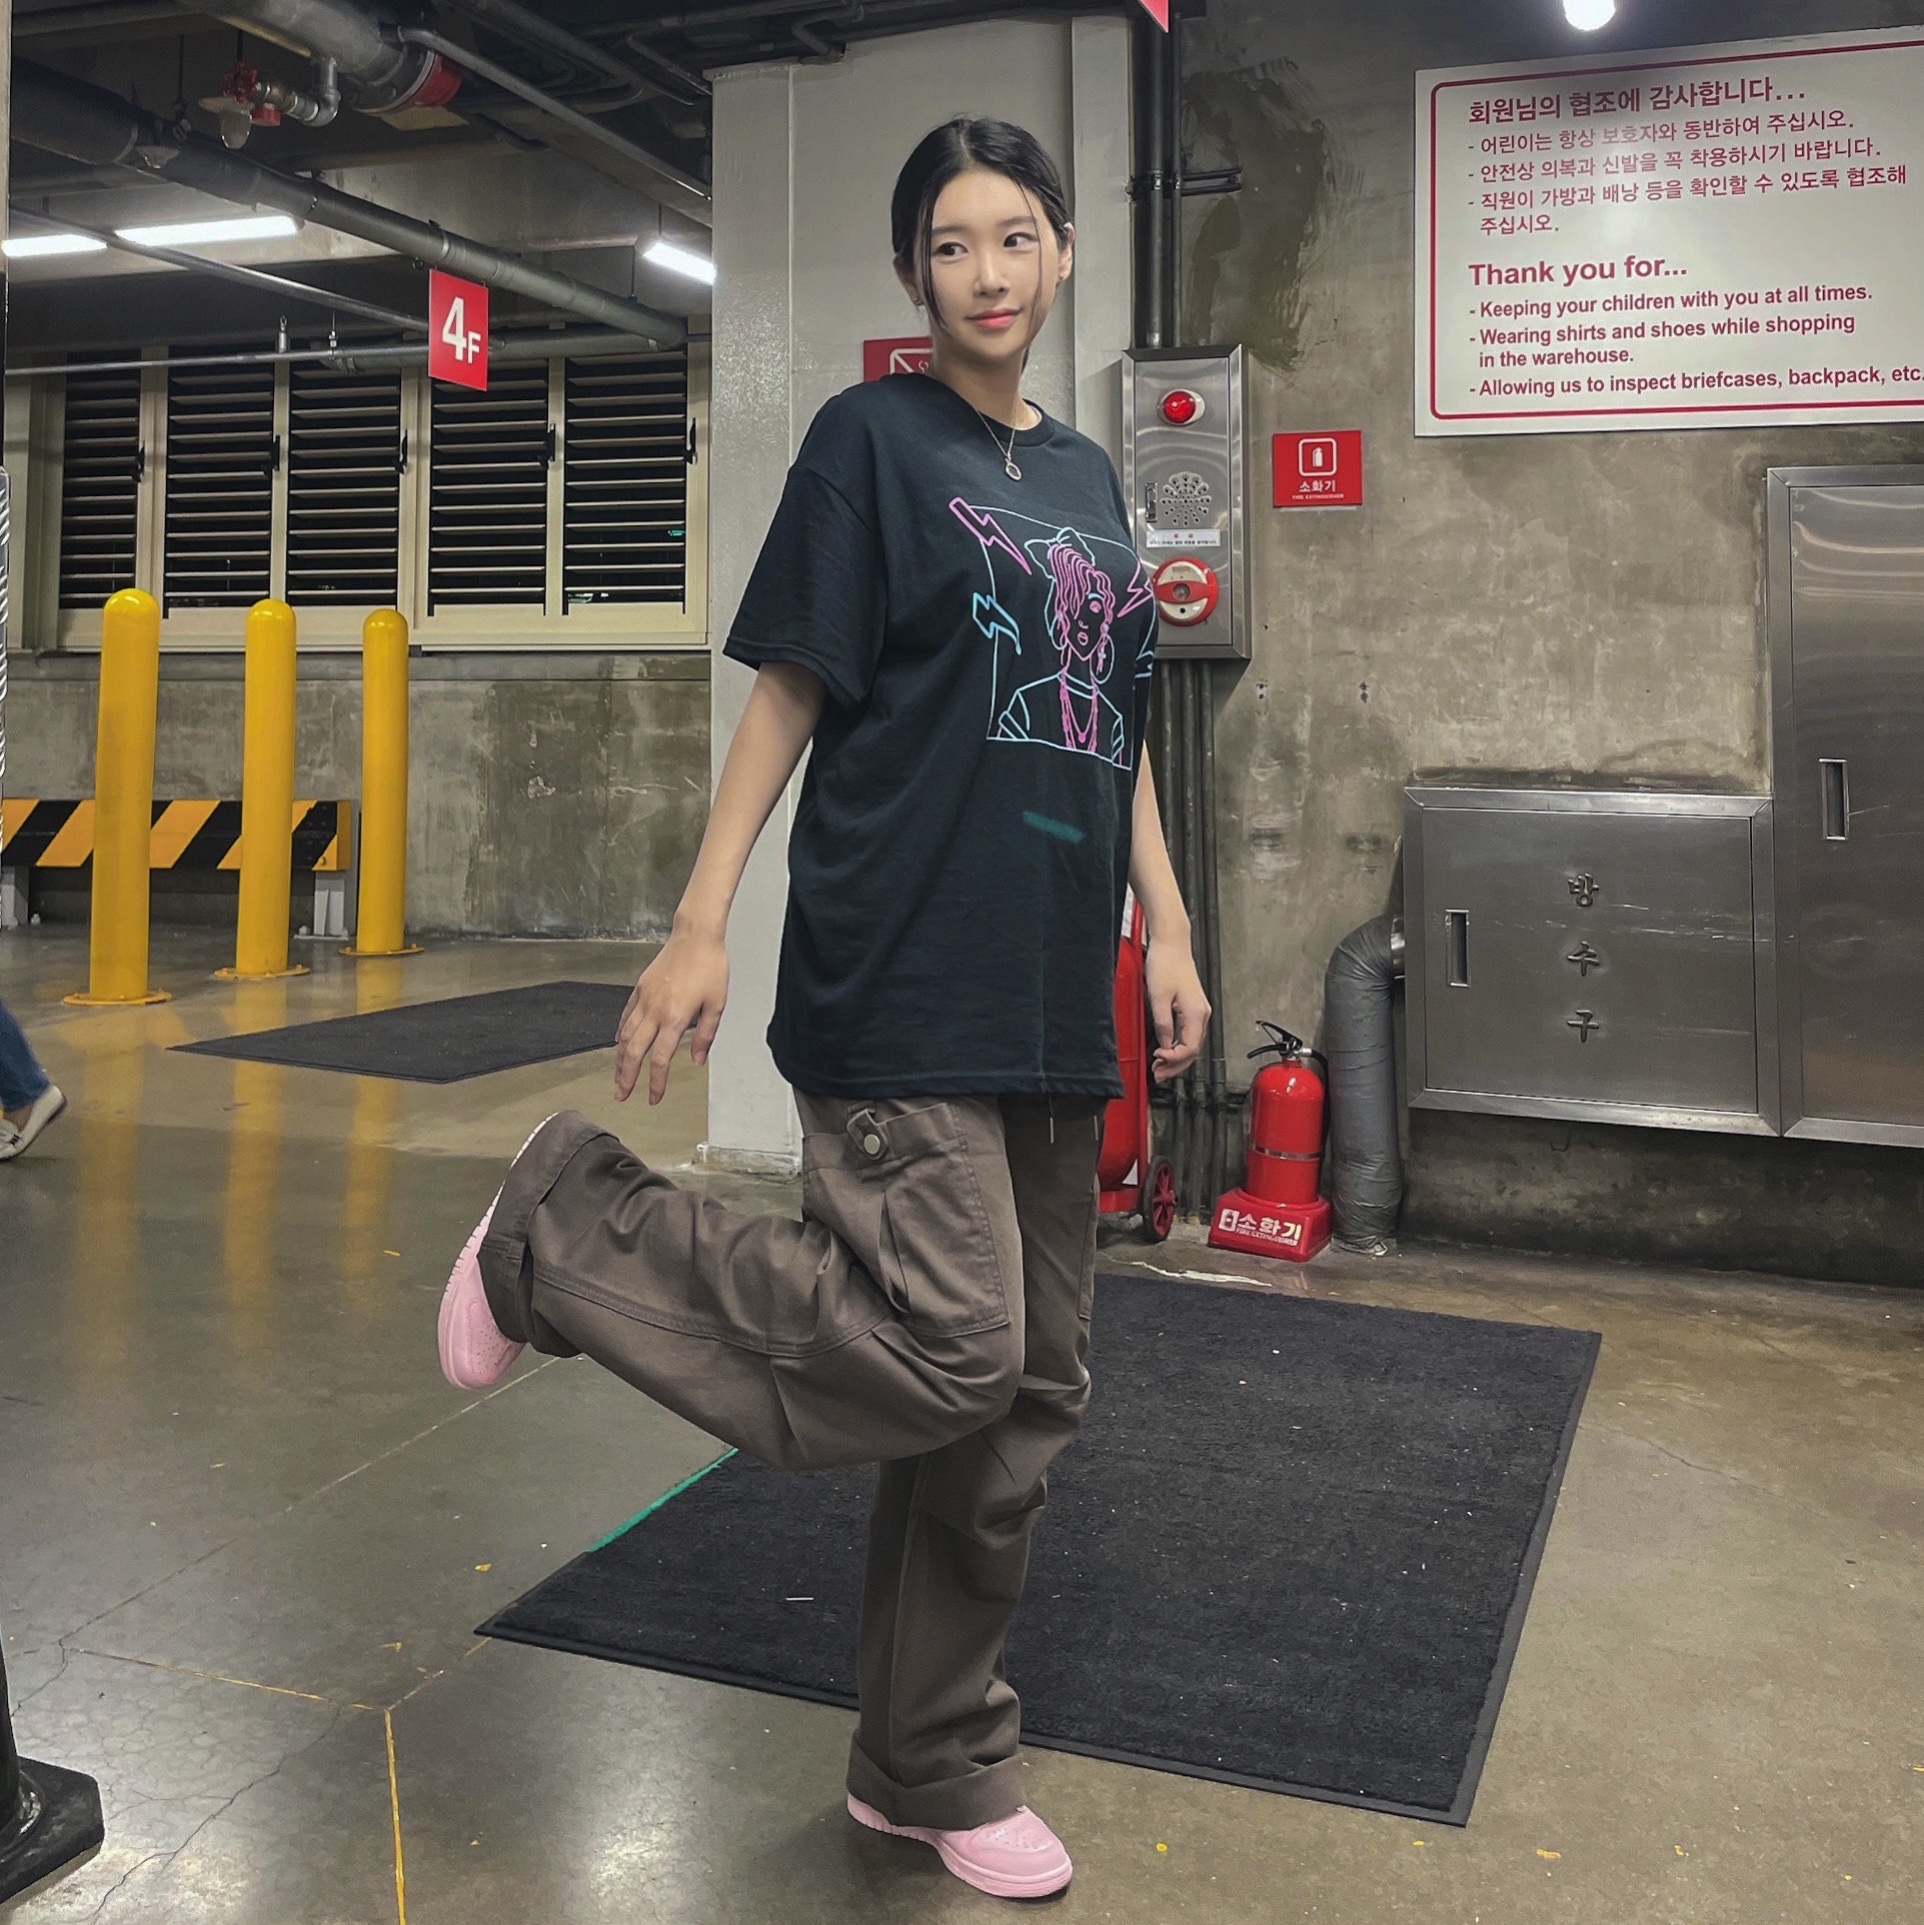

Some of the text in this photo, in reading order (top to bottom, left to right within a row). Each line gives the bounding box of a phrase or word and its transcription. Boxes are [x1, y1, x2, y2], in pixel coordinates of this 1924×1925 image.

[1469, 77, 1804, 124] 회원님의 협조에 감사합니다...
[1482, 111, 1853, 154] 어린이는 항상 보호자와 동반하여 주십시오.
[1481, 137, 1880, 183] 안전상 의복과 신발을 꼭 착용하시기 바랍니다.
[1482, 165, 1905, 210] 직원이 가방과 배낭 등을 확인할 수 있도록 협조해
[1481, 215, 1558, 235] 주십시오.
[1469, 255, 1686, 287] Thank you for...
[1481, 285, 1871, 320] Keeping your children with you at all times.
[442, 296, 481, 364] 4F
[1480, 314, 1854, 346] Wearing shirts and shoes while shopping
[1480, 348, 1633, 367] in the warehouse.
[1480, 378, 1554, 397] Allowing
[1561, 381, 1581, 393] us
[1587, 377, 1604, 392] to
[1611, 374, 1676, 394] inspect
[1682, 371, 1782, 388] briefcases,
[1789, 366, 1885, 387] backpack,
[1299, 480, 1336, 492] 소화기
[1237, 1213, 1302, 1240] 소화기
